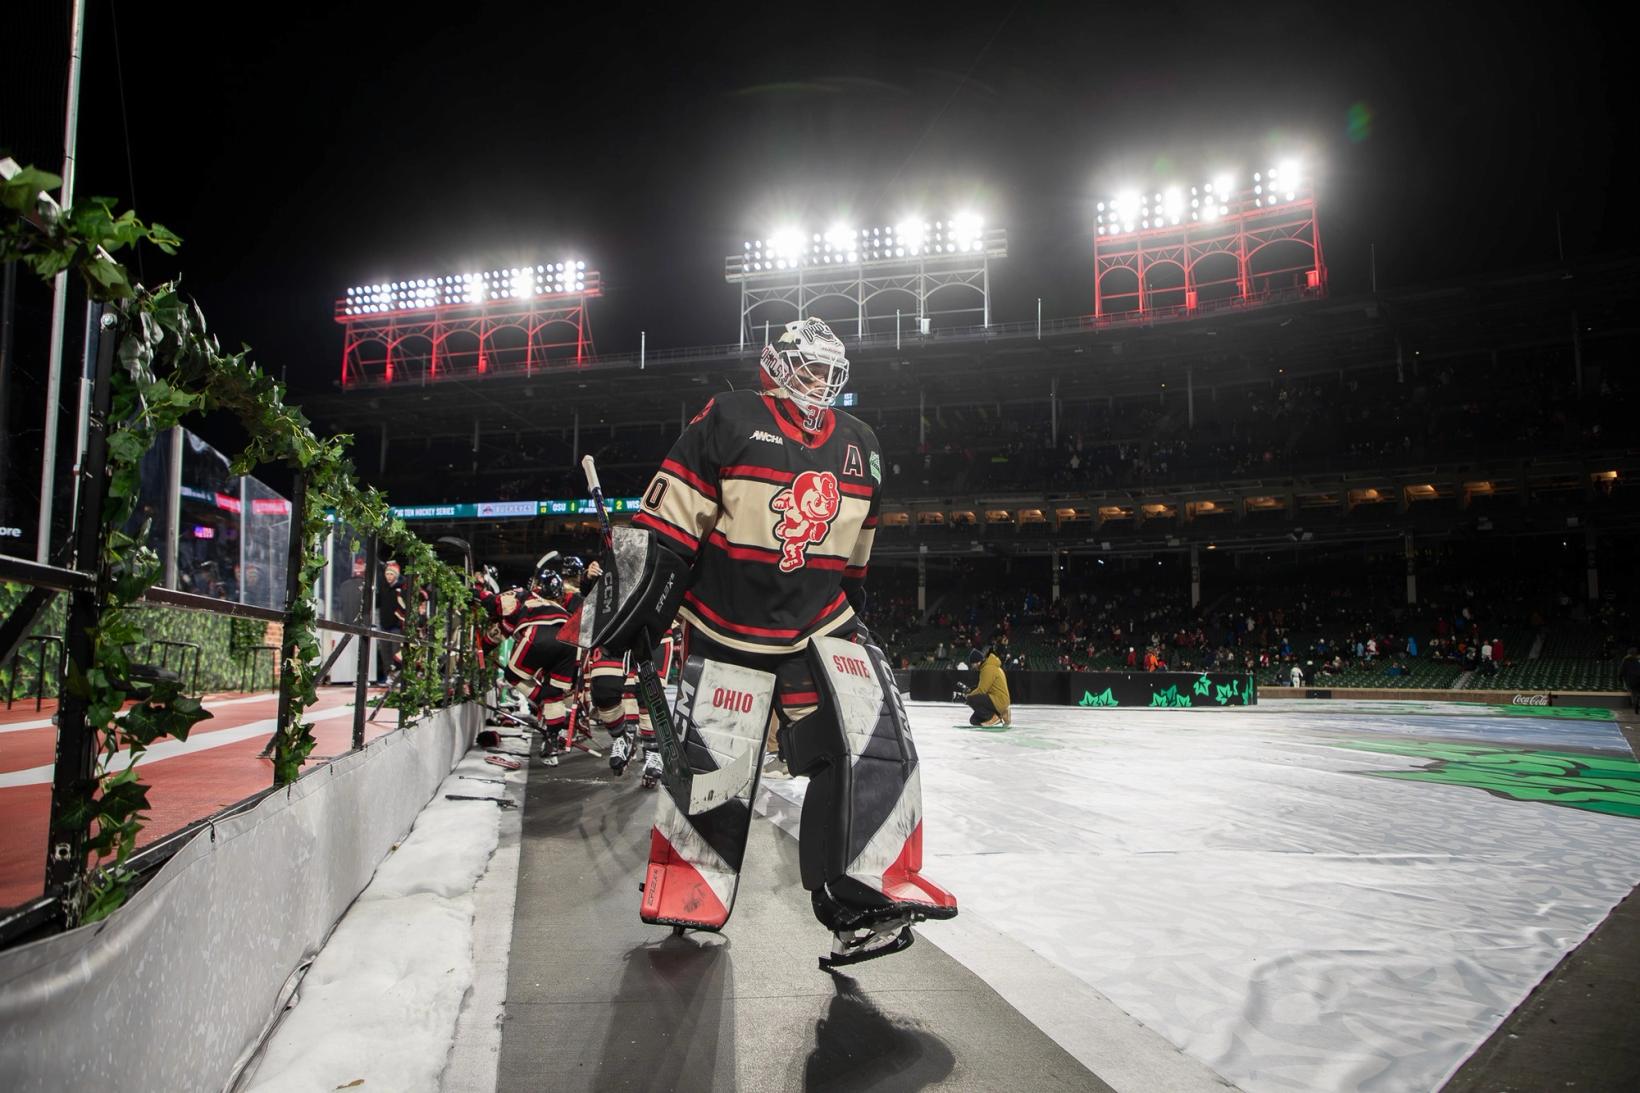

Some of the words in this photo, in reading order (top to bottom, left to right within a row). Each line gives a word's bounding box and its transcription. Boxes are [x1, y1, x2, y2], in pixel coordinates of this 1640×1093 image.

[842, 444, 864, 478] A
[415, 507, 435, 516] HOCKEY
[436, 507, 455, 515] SERIES
[552, 503, 566, 511] OSU
[616, 500, 622, 509] 2
[602, 571, 613, 614] CCM
[833, 654, 871, 679] STATE
[640, 659, 680, 763] BAUER
[674, 680, 696, 743] CM
[712, 687, 754, 714] OHIO
[880, 659, 914, 741] CCM
[1512, 694, 1549, 706] Coca-Cola
